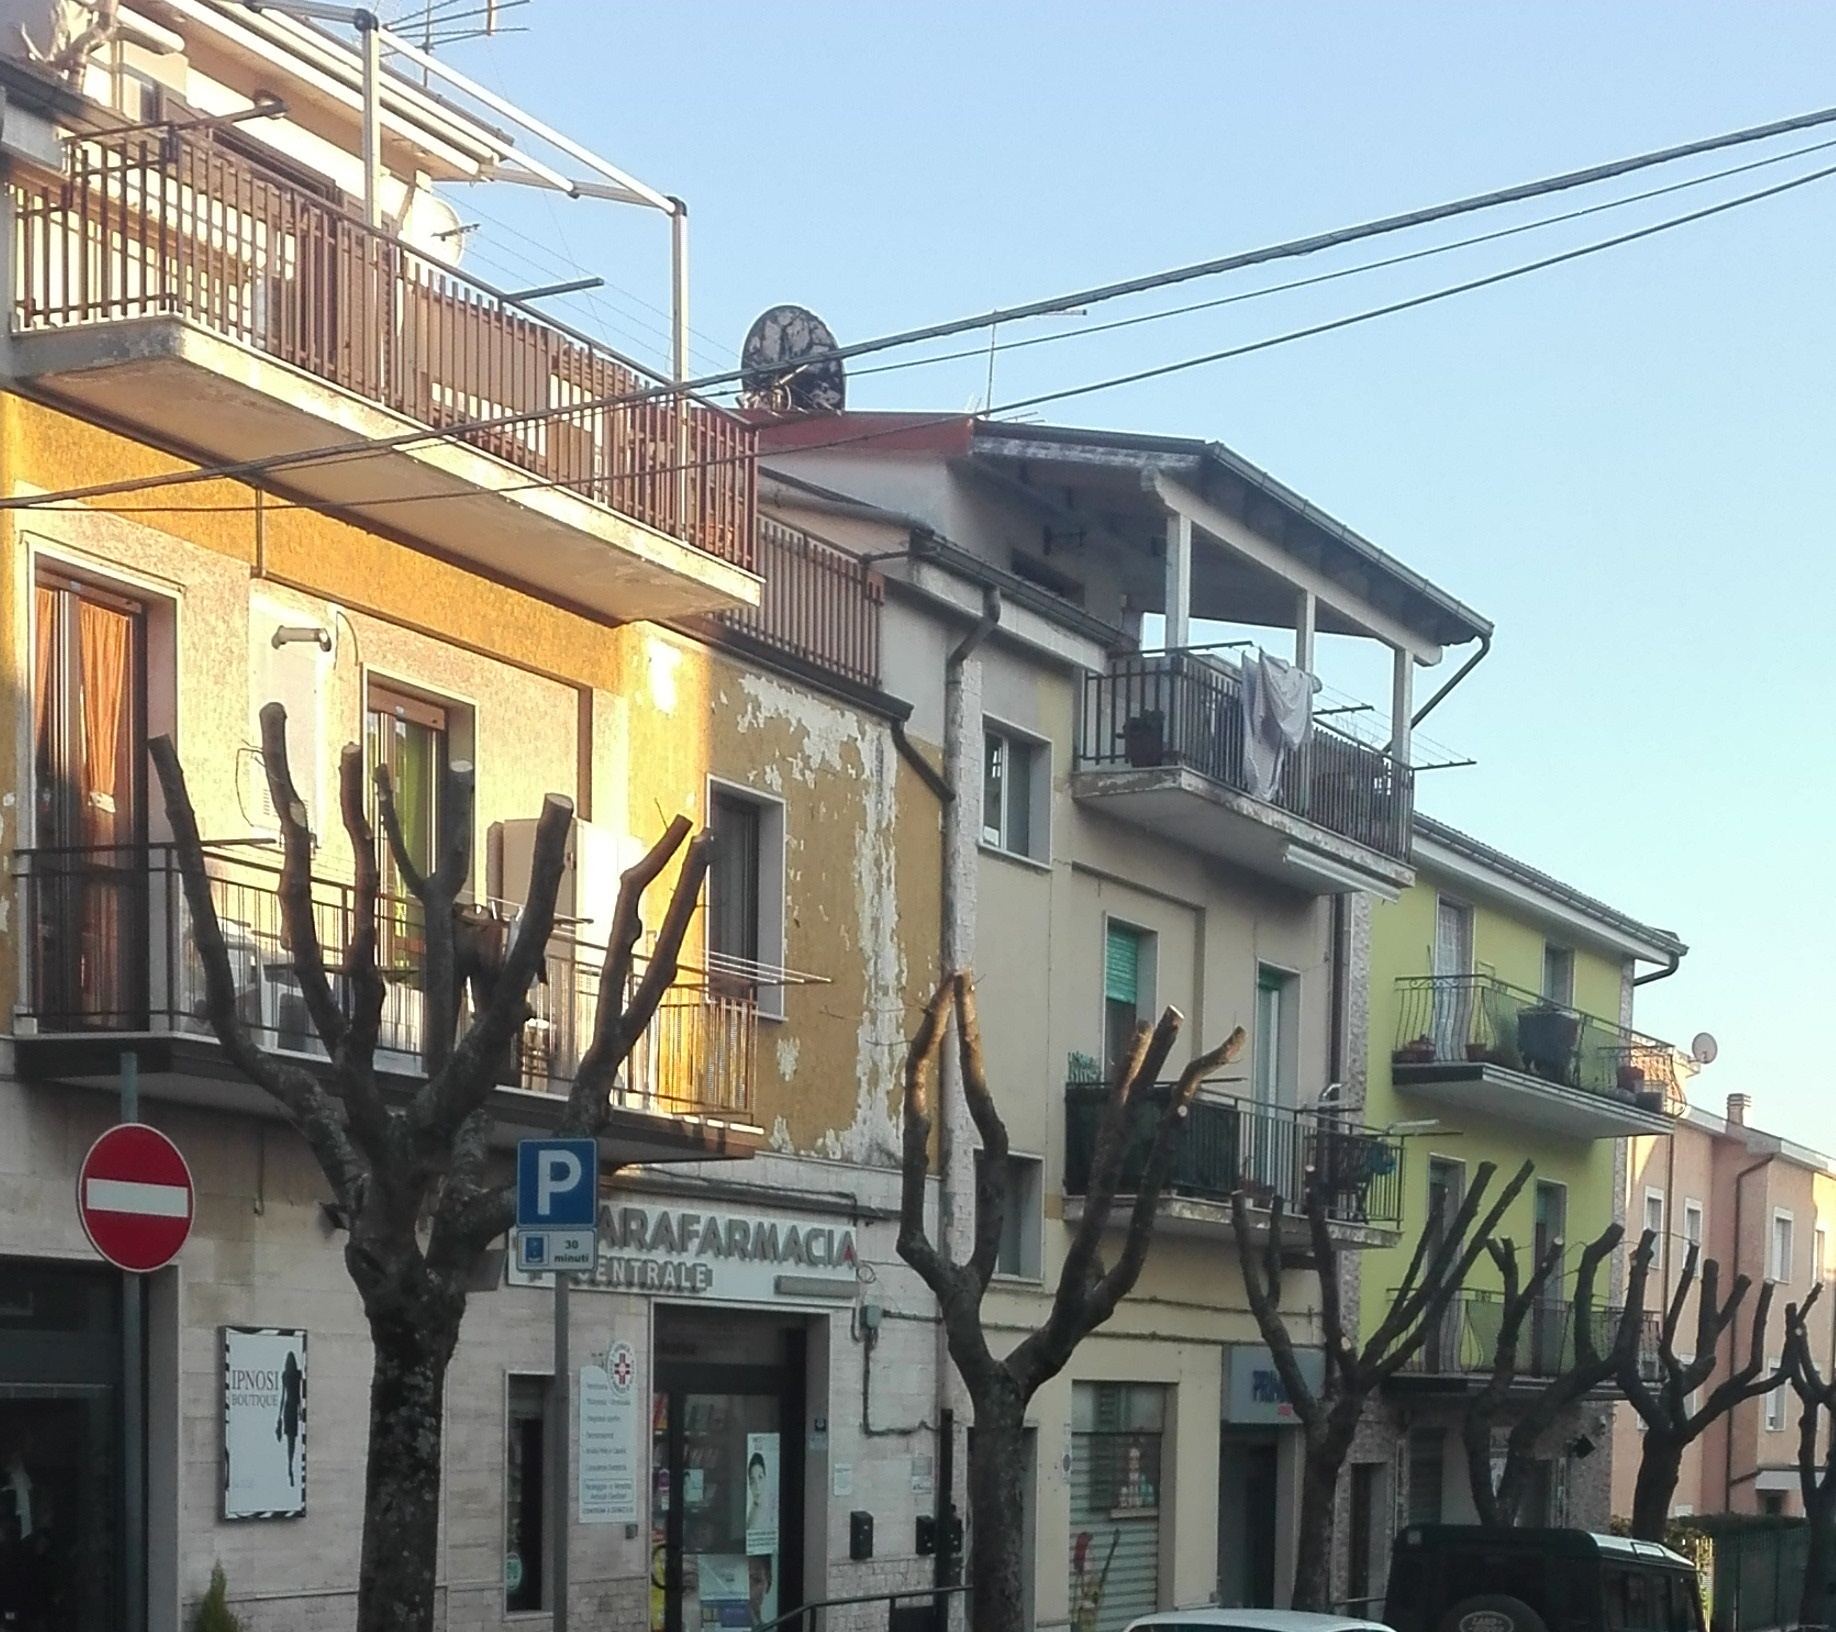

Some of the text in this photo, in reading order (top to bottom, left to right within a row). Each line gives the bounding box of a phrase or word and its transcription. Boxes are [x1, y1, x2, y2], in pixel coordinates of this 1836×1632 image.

[537, 1149, 582, 1215] P
[564, 1240, 579, 1250] 30
[599, 1204, 859, 1268] ARAFARMACIA
[554, 1252, 589, 1263] minuti
[578, 1257, 709, 1289] ENTRALE
[231, 1369, 279, 1391] IPNOSI
[231, 1393, 278, 1408] BOUTIQUE
